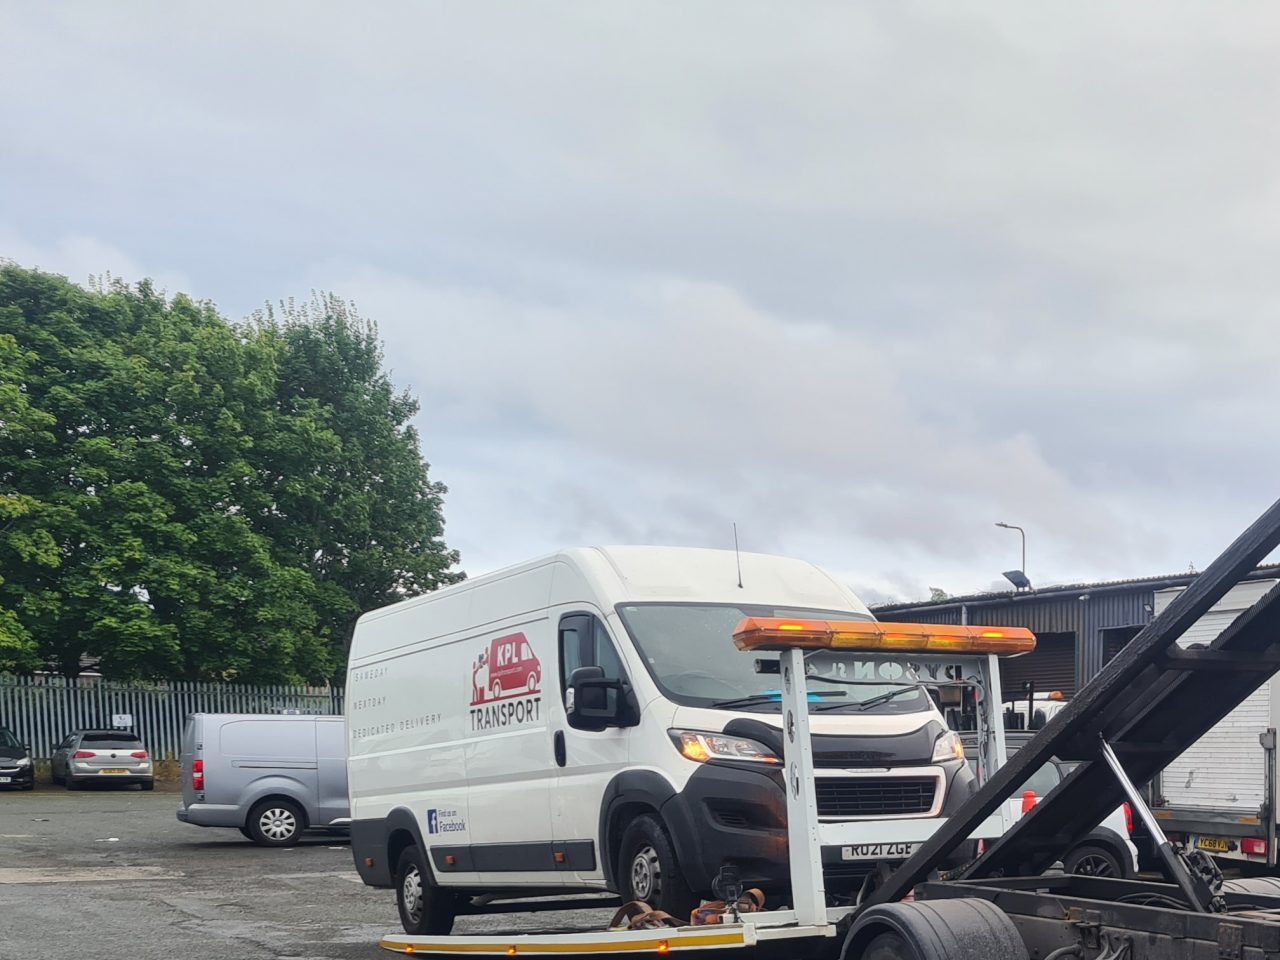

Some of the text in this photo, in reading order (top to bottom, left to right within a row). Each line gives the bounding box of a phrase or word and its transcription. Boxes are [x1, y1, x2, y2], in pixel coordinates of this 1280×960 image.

[497, 642, 518, 666] KPL
[352, 713, 442, 739] DEDICATED DELIVERY
[470, 697, 541, 731] TRANSPORT
[439, 819, 466, 832] Facebook
[1200, 837, 1217, 849] YC68
